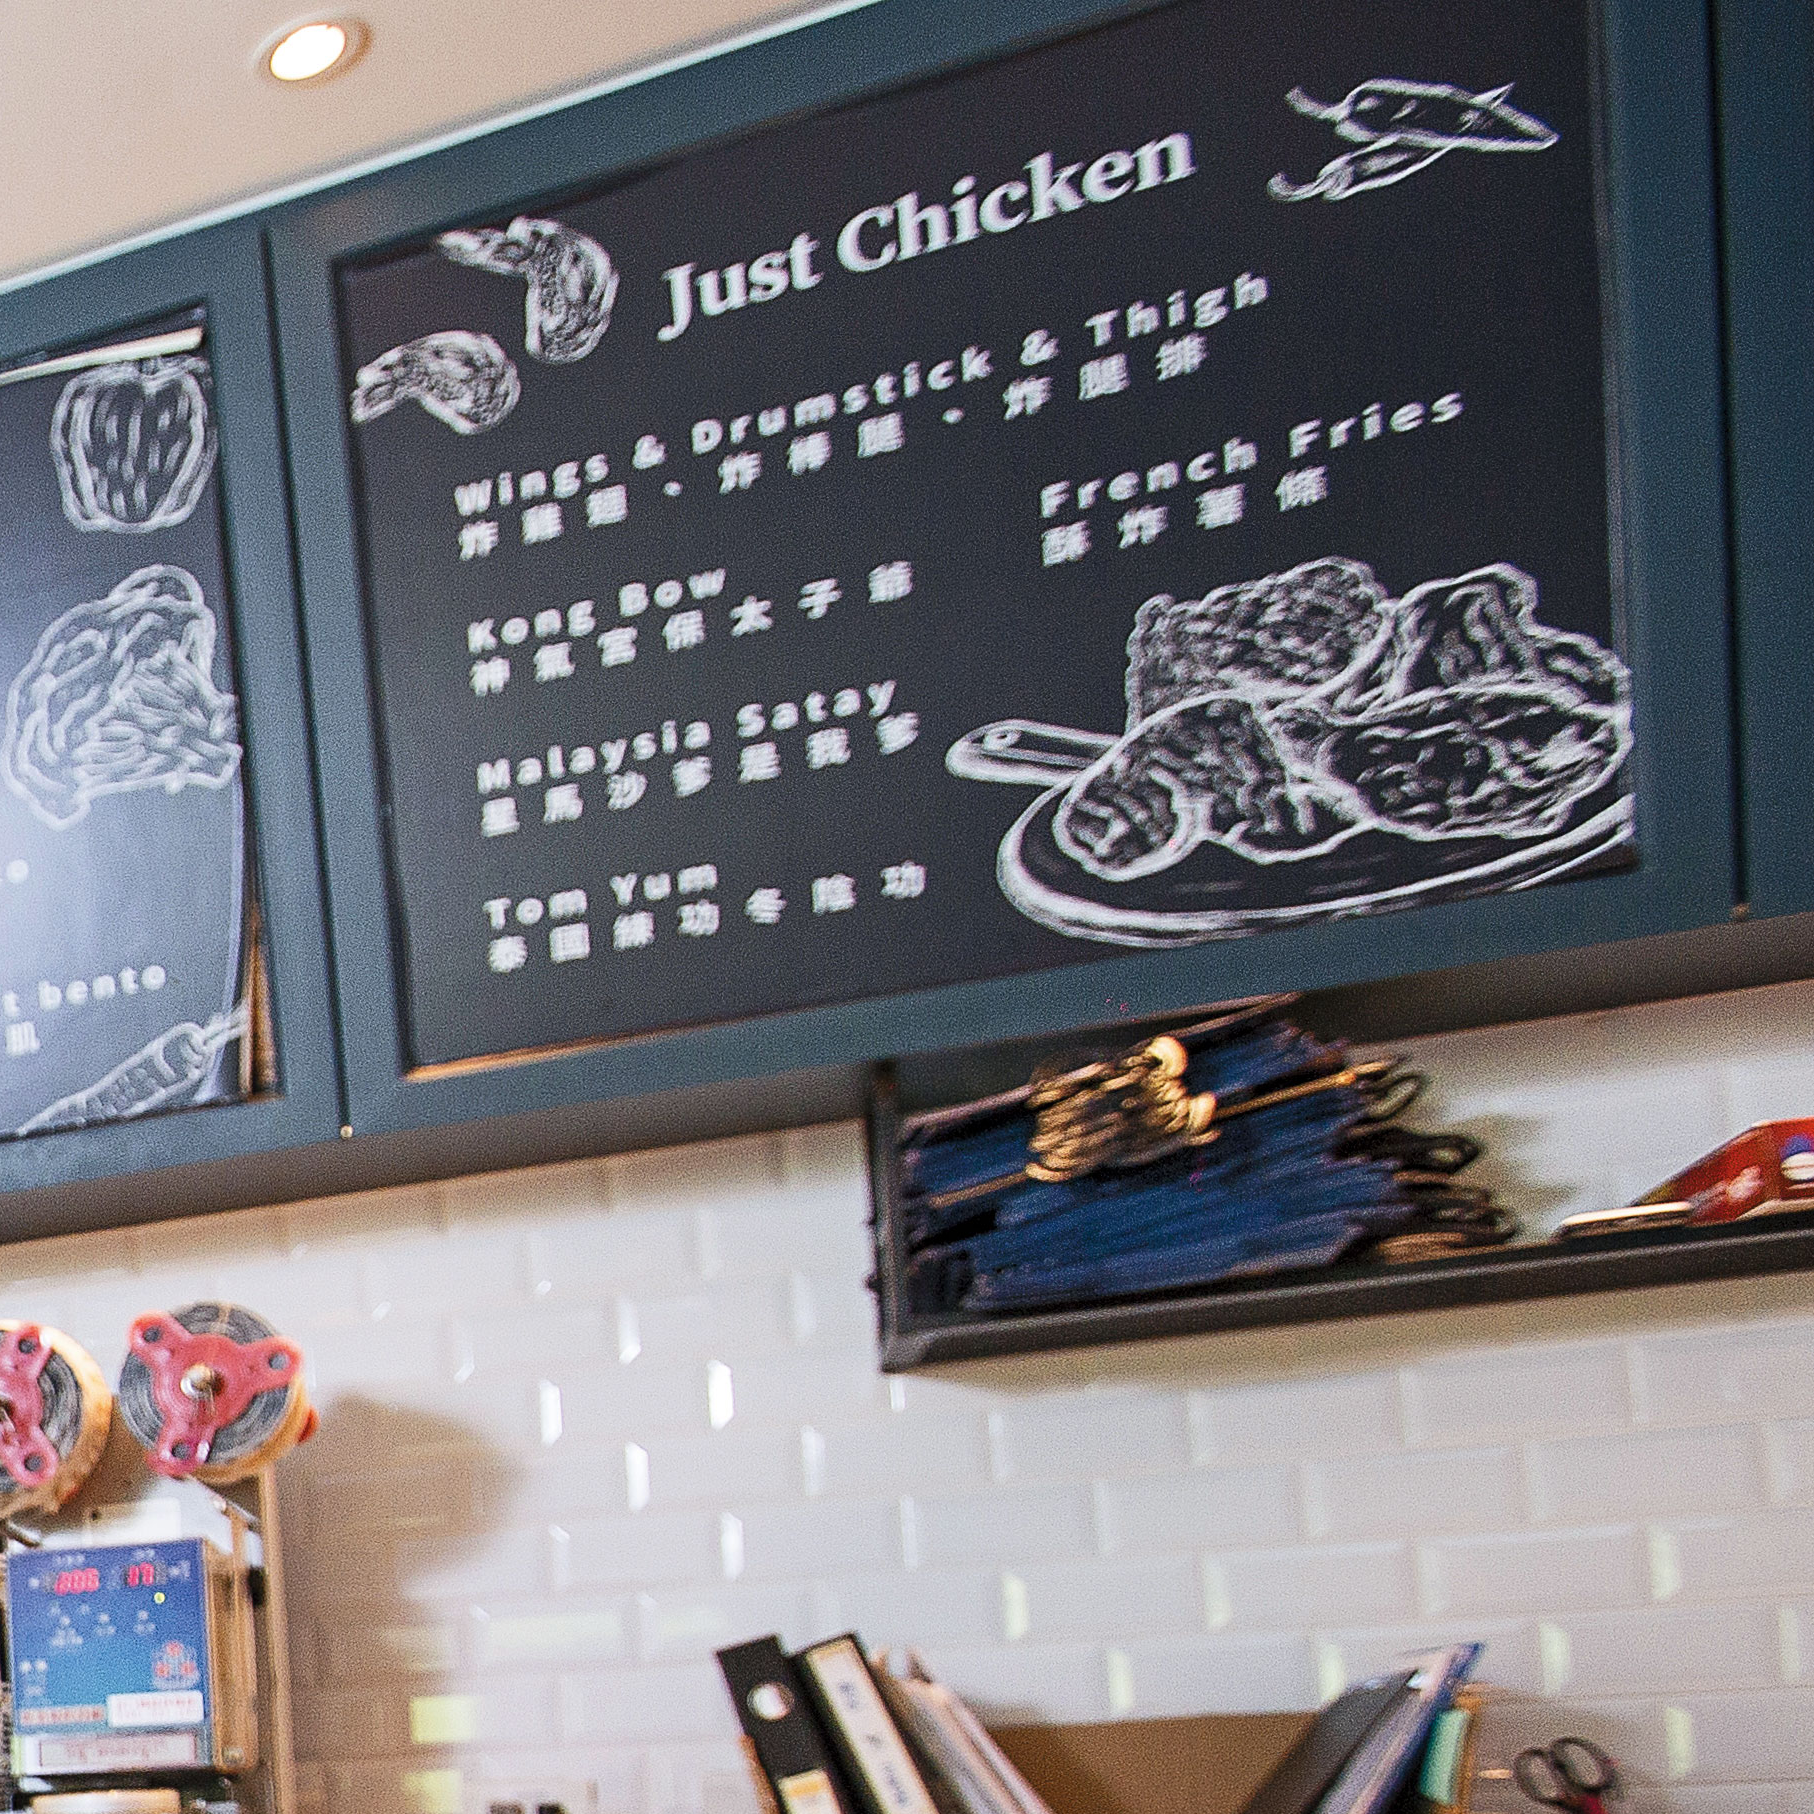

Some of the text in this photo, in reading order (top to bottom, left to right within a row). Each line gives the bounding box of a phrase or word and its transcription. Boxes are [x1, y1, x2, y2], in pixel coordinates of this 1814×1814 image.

[657, 131, 1198, 342] Just Chicken
[454, 271, 1271, 517] Wings & Drumstick & Thigh
[1039, 391, 1464, 519] French Fries
[467, 567, 726, 655] Kong Bow
[476, 679, 897, 794] Malaysia Satay
[482, 863, 719, 930] Tom Yum
[36, 963, 166, 1012] bento
